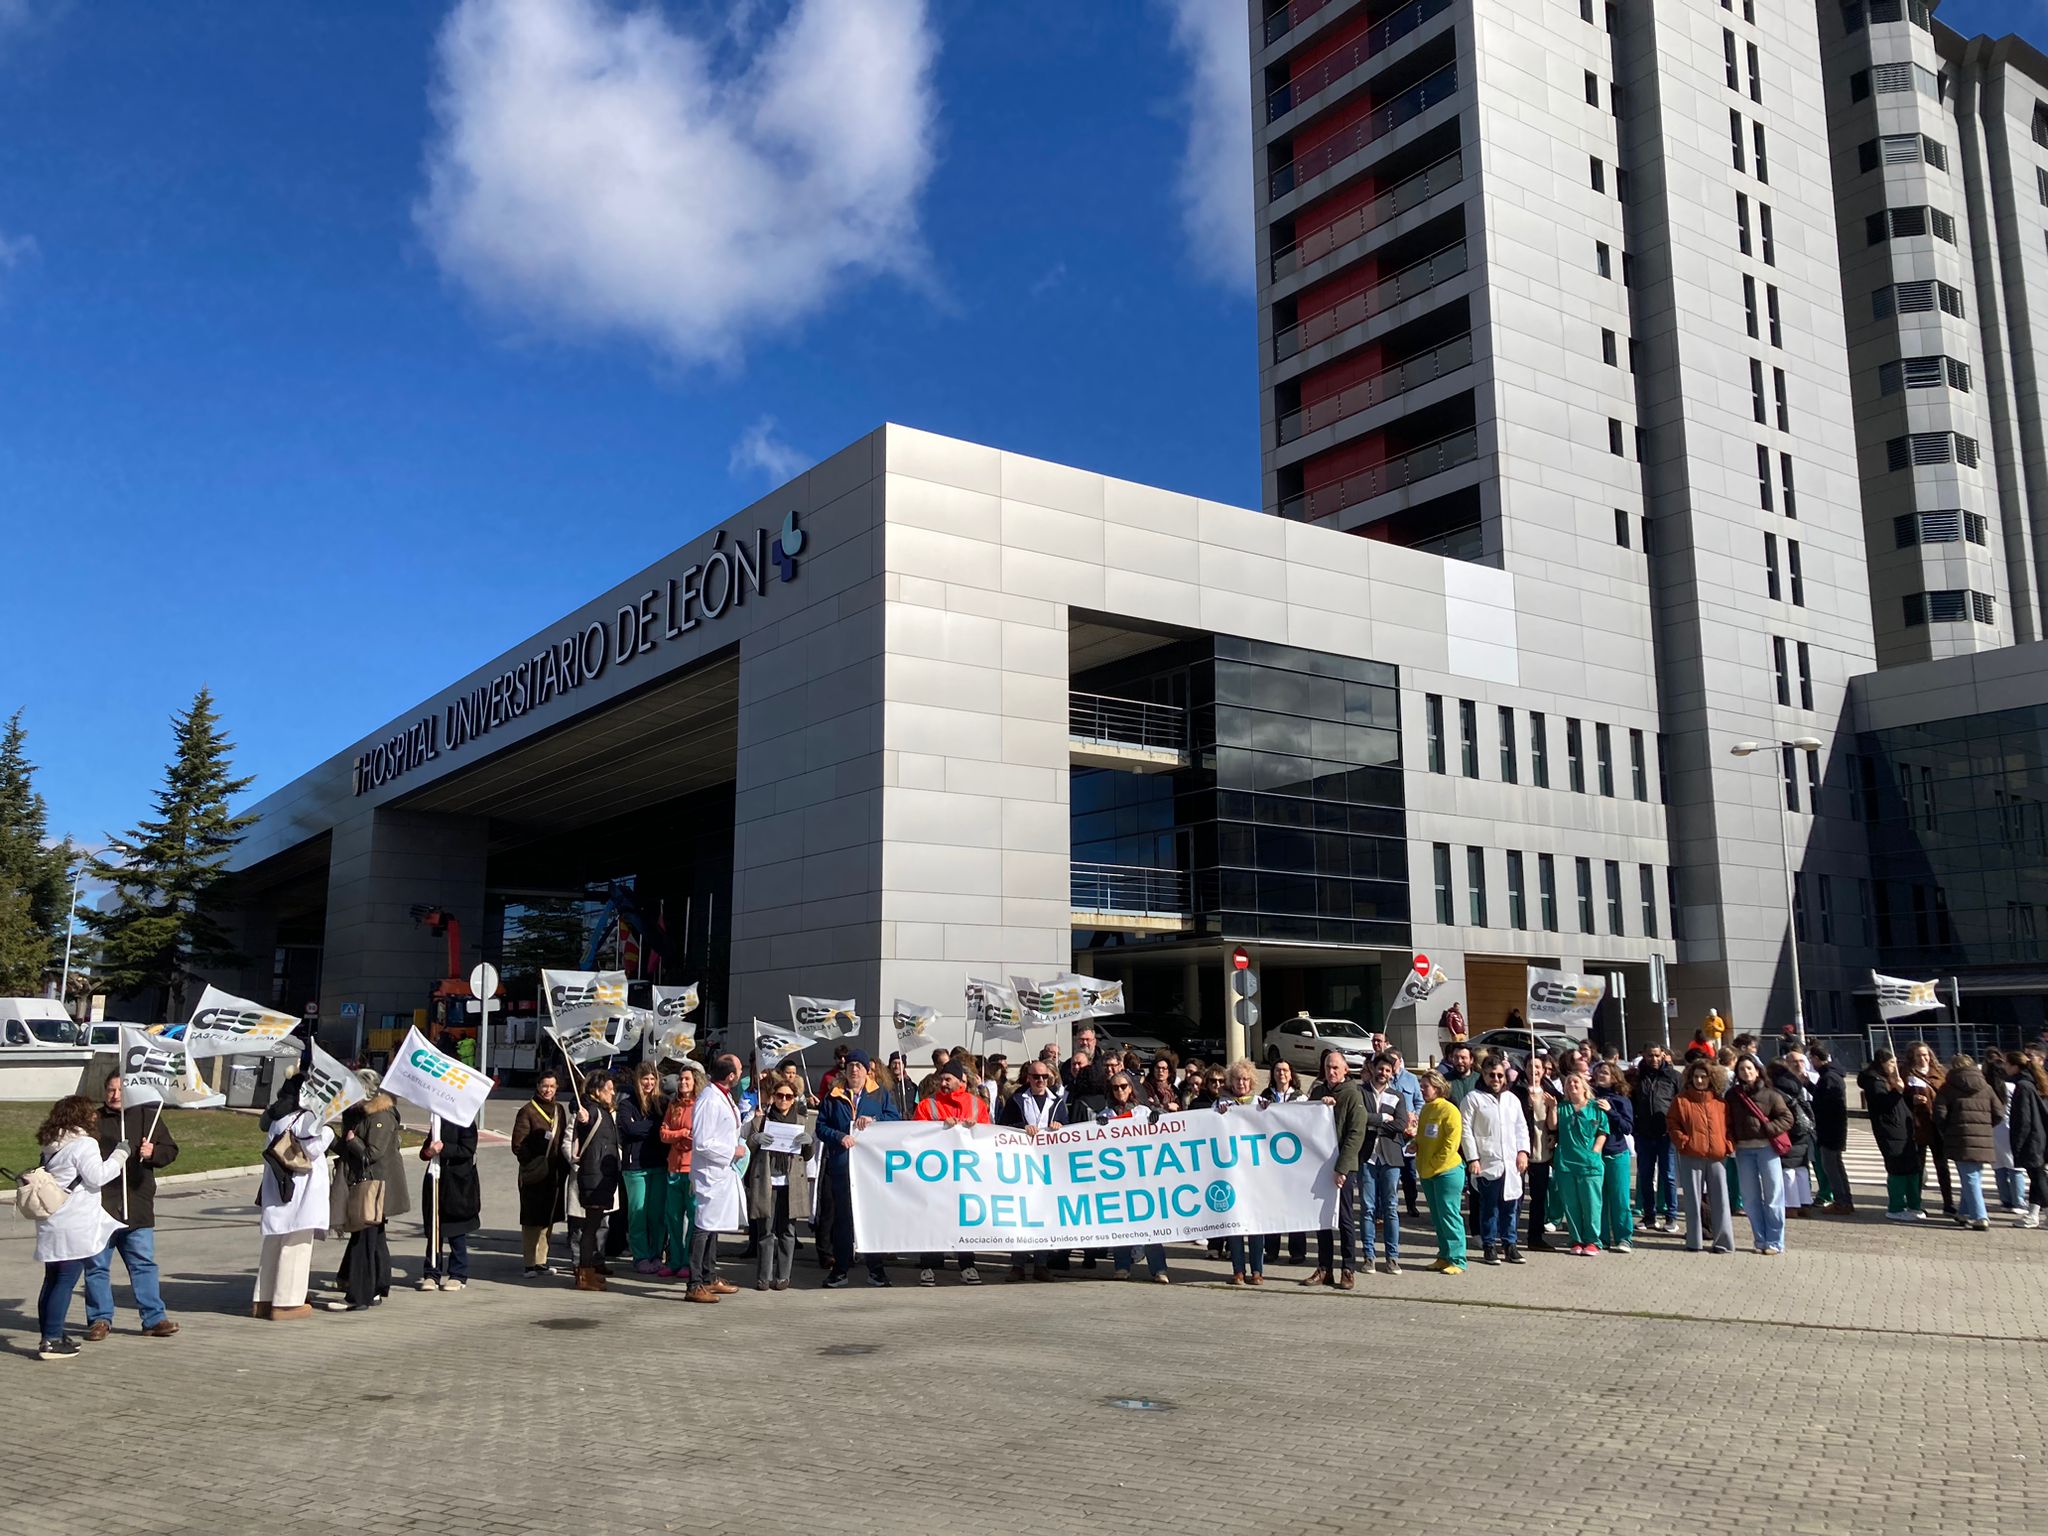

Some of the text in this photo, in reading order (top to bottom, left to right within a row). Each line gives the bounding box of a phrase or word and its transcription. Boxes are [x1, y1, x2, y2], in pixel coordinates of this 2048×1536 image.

[361, 528, 766, 793] HOSPITAL UNIVERSITARIO DE LEÓN
[1086, 1127, 1107, 1141] LA
[1110, 1120, 1187, 1139] SANIDAD!
[885, 1131, 1303, 1185] POR UN ESTATUTO
[958, 1193, 1045, 1228] DEL
[958, 1235, 1003, 1244] Asociación
[1005, 1235, 1015, 1244] de
[1050, 1234, 1078, 1243] Unidos
[1080, 1233, 1094, 1243] por
[1153, 1227, 1172, 1237] MUD
